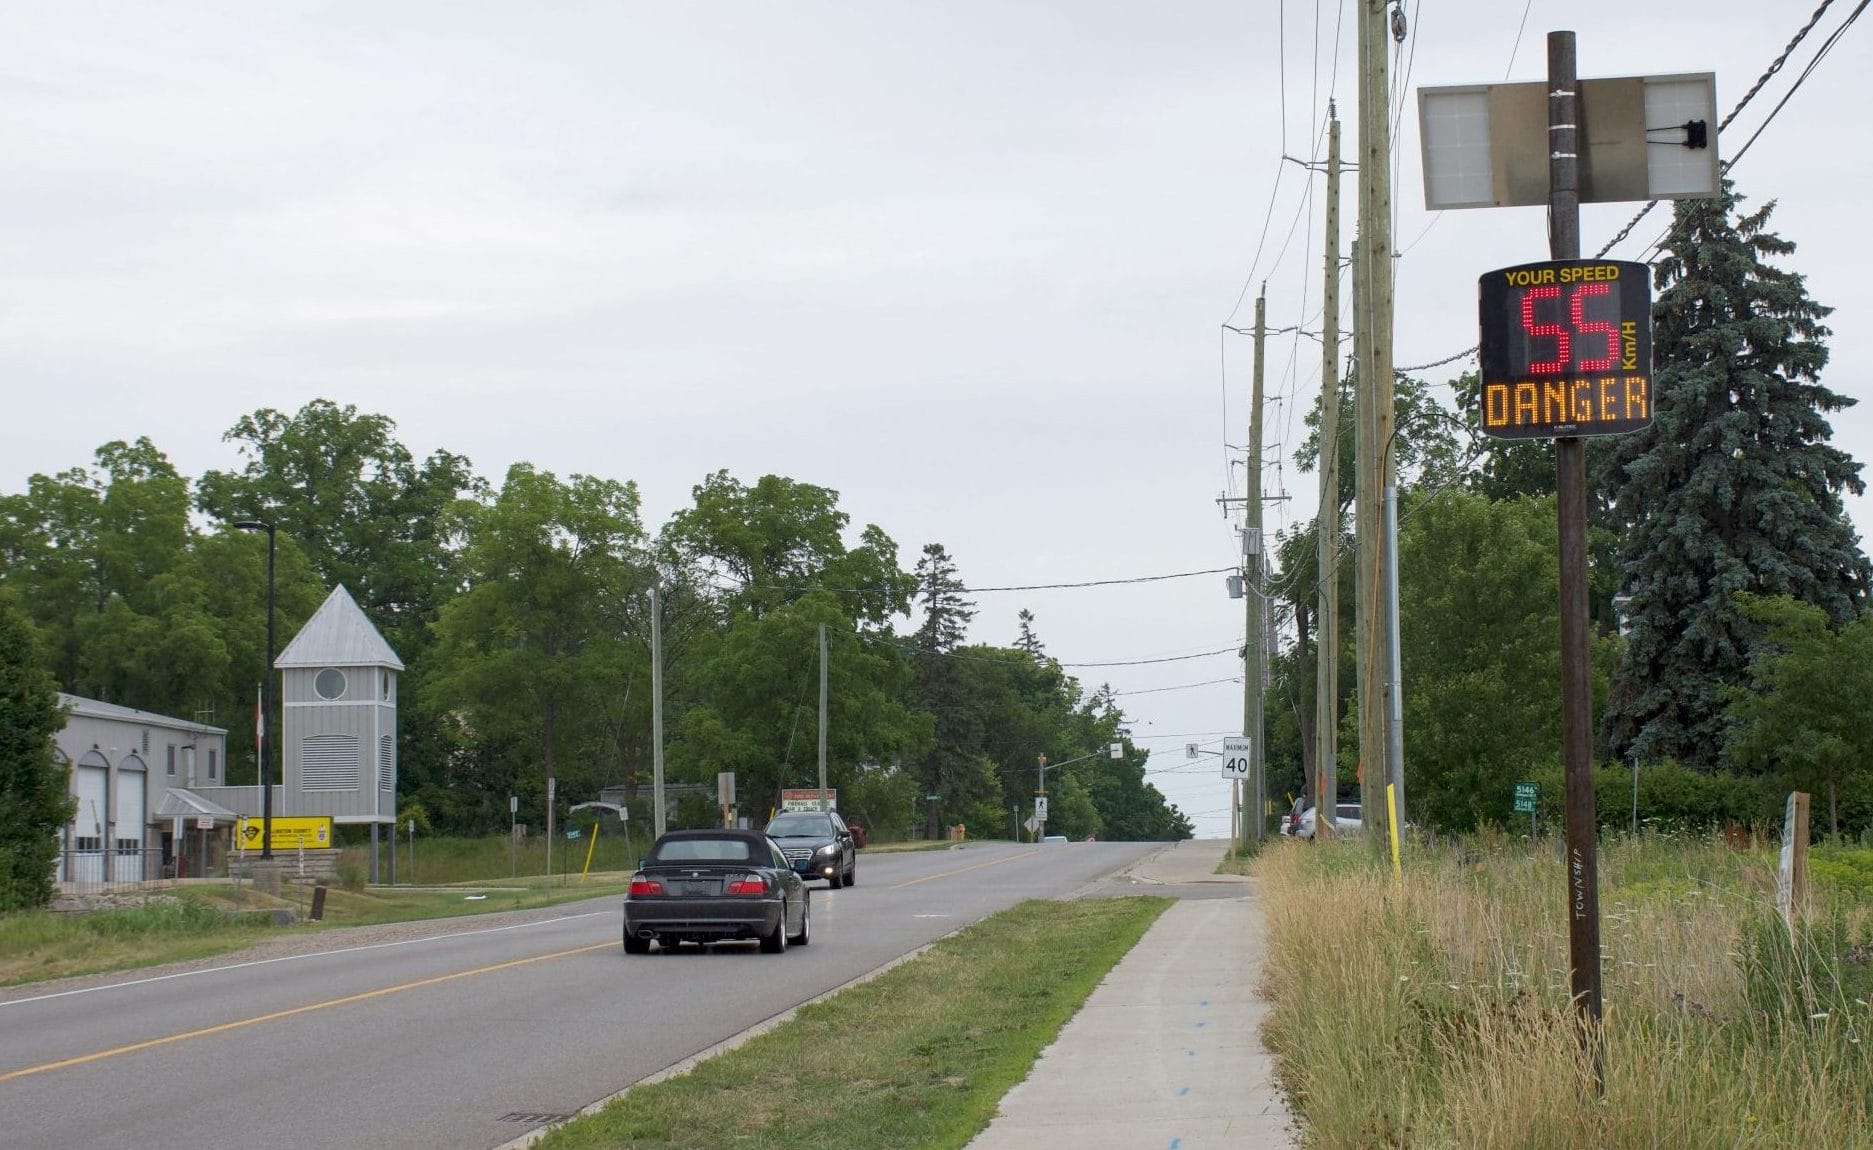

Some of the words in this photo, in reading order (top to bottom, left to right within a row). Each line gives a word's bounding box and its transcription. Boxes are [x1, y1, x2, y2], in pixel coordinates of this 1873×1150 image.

[1505, 269, 1555, 286] YOUR
[1560, 265, 1620, 283] SPEED
[1522, 283, 1621, 374] 55
[1622, 321, 1636, 370] Km/H
[1486, 376, 1647, 427] DANGER
[1226, 757, 1248, 773] 40
[1516, 785, 1535, 794] 5146
[1573, 848, 1588, 921] TOWNSHIP
